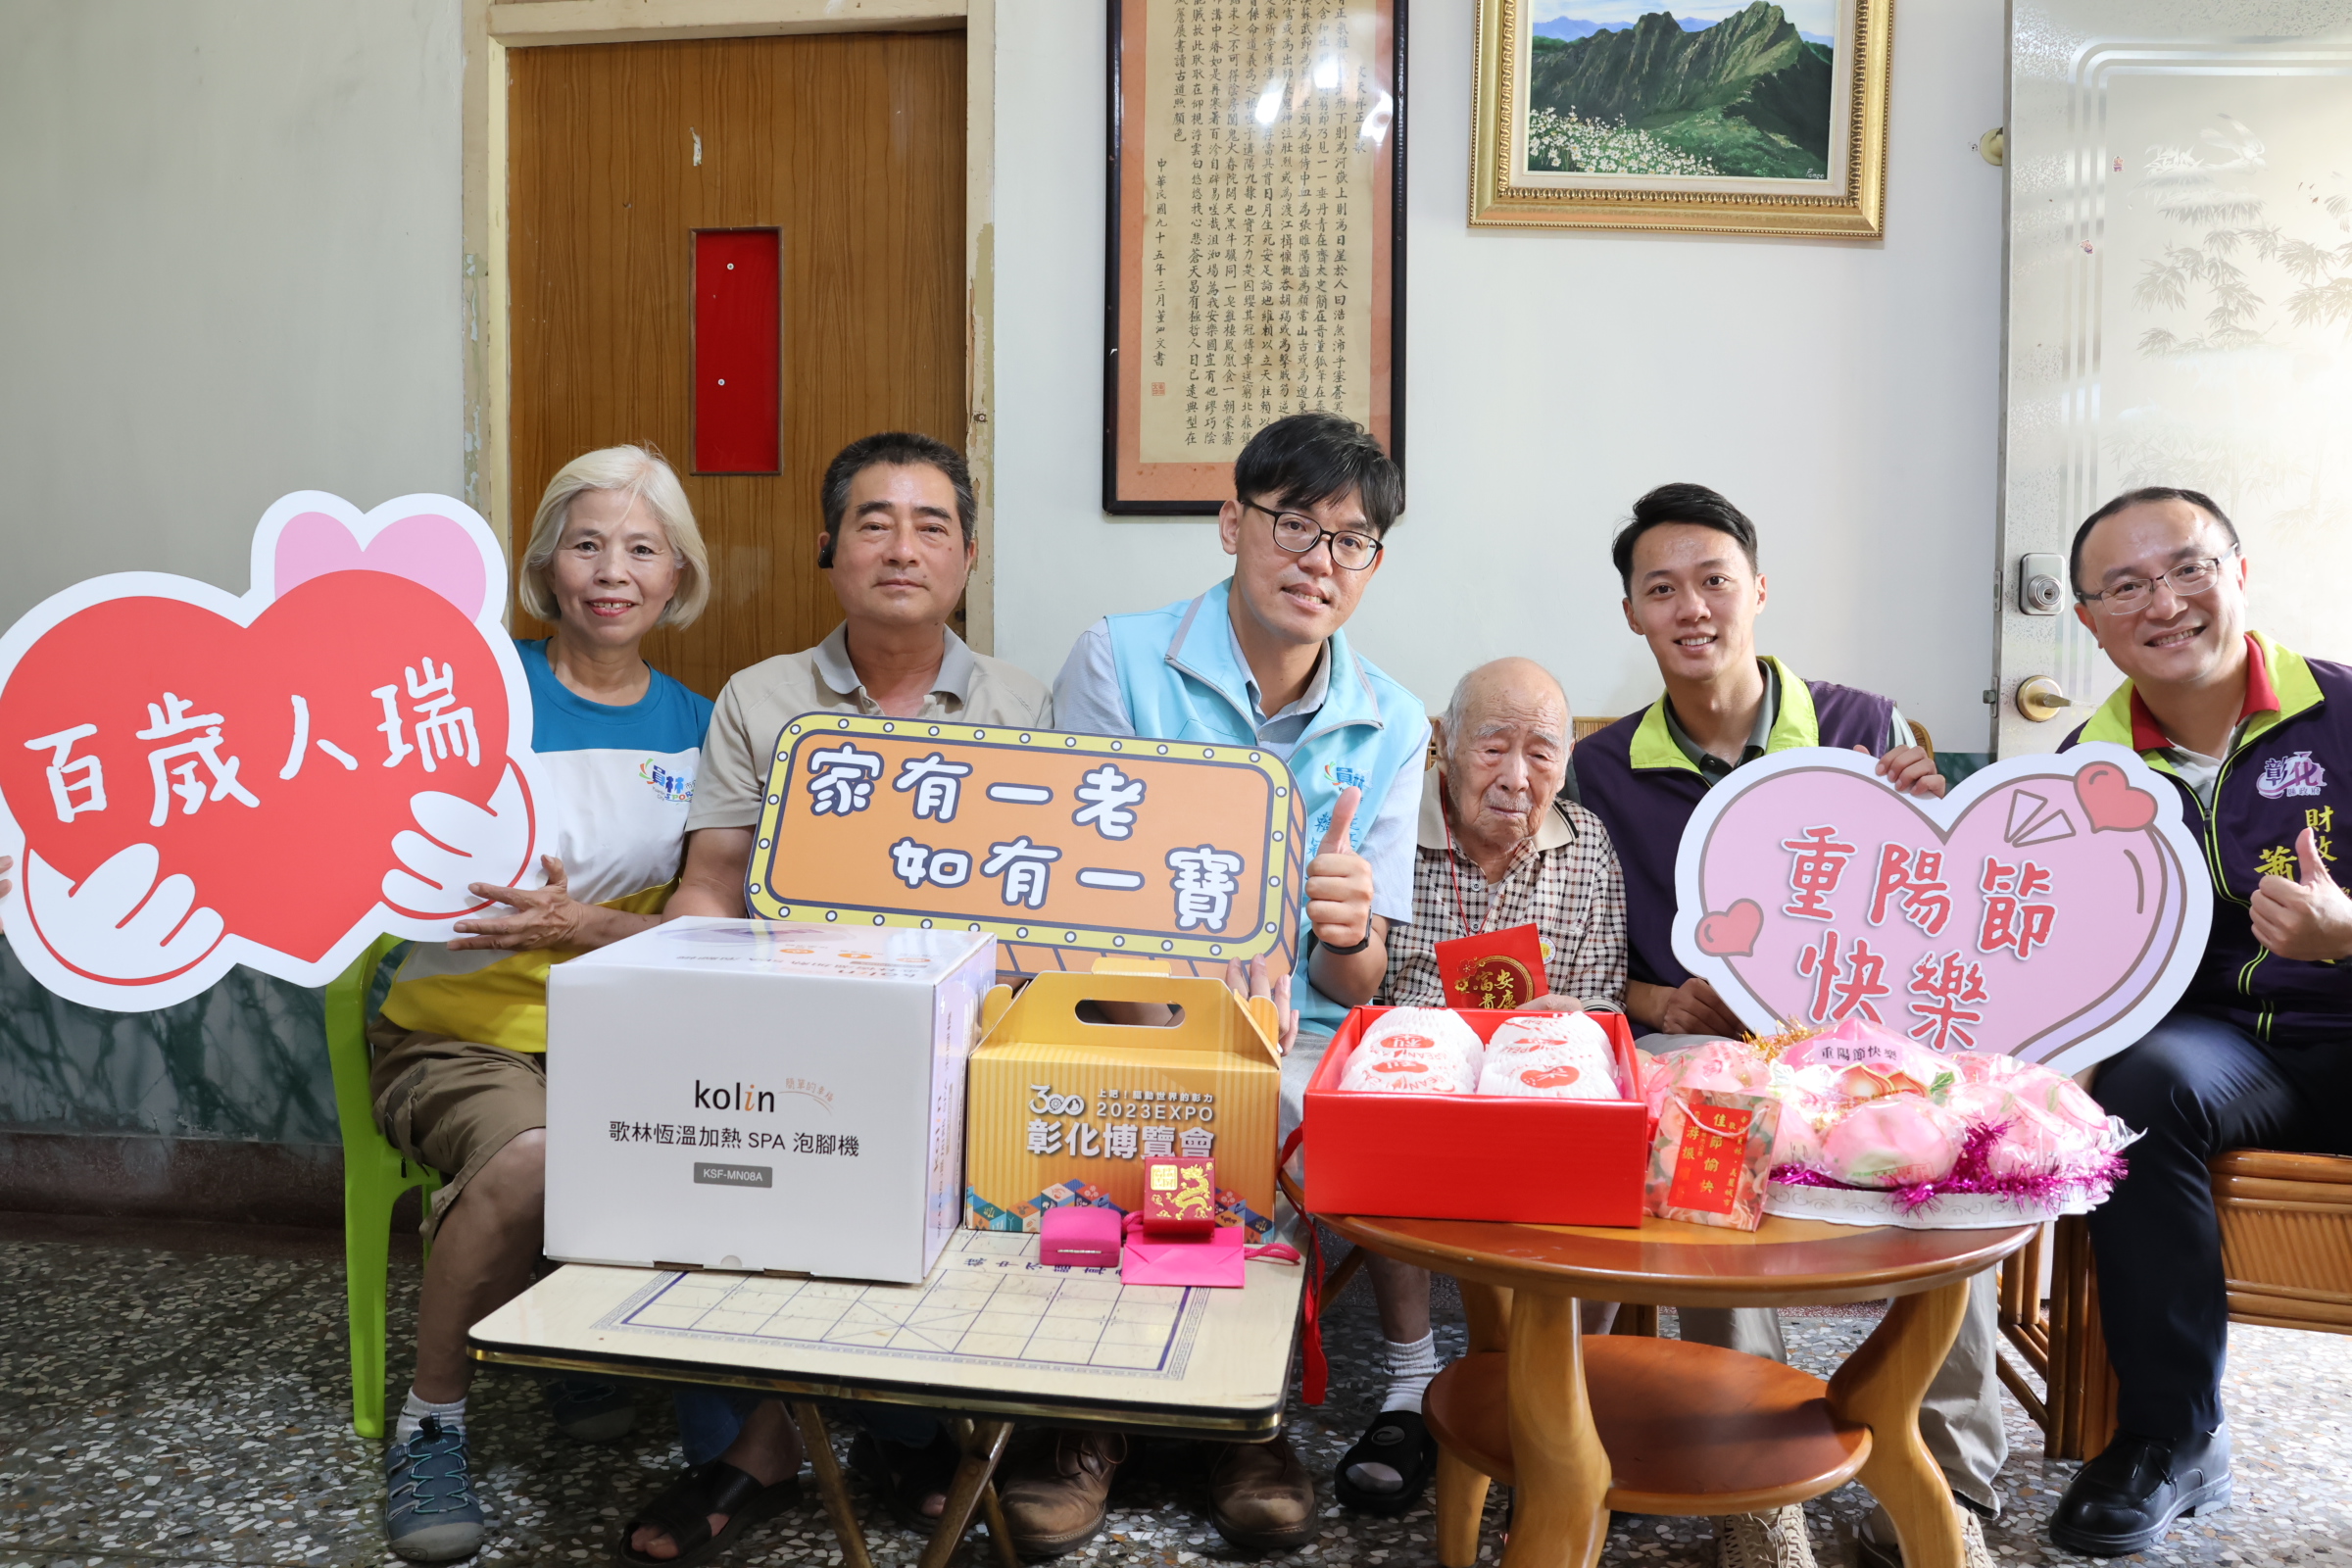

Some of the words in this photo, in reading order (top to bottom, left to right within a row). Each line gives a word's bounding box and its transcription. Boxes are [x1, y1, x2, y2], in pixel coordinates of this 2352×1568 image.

[24, 656, 480, 827] 百歲人瑞
[808, 742, 1145, 840] 家有一老
[890, 835, 1245, 933] 如有一寶
[1783, 824, 2058, 960] 重陽節
[1797, 929, 1989, 1052] 快樂
[1821, 1045, 1897, 1061] 重陽節快樂
[695, 1080, 775, 1113] kolin
[609, 1120, 742, 1150] 歌林恆溫加熱
[748, 1132, 785, 1151] SPA
[793, 1132, 859, 1157] 泡腳機
[703, 1168, 763, 1182] KSF-MN08A
[1026, 1118, 1214, 1160] 彰化博覽會
[1699, 1114, 1727, 1194] 佳節愉快
